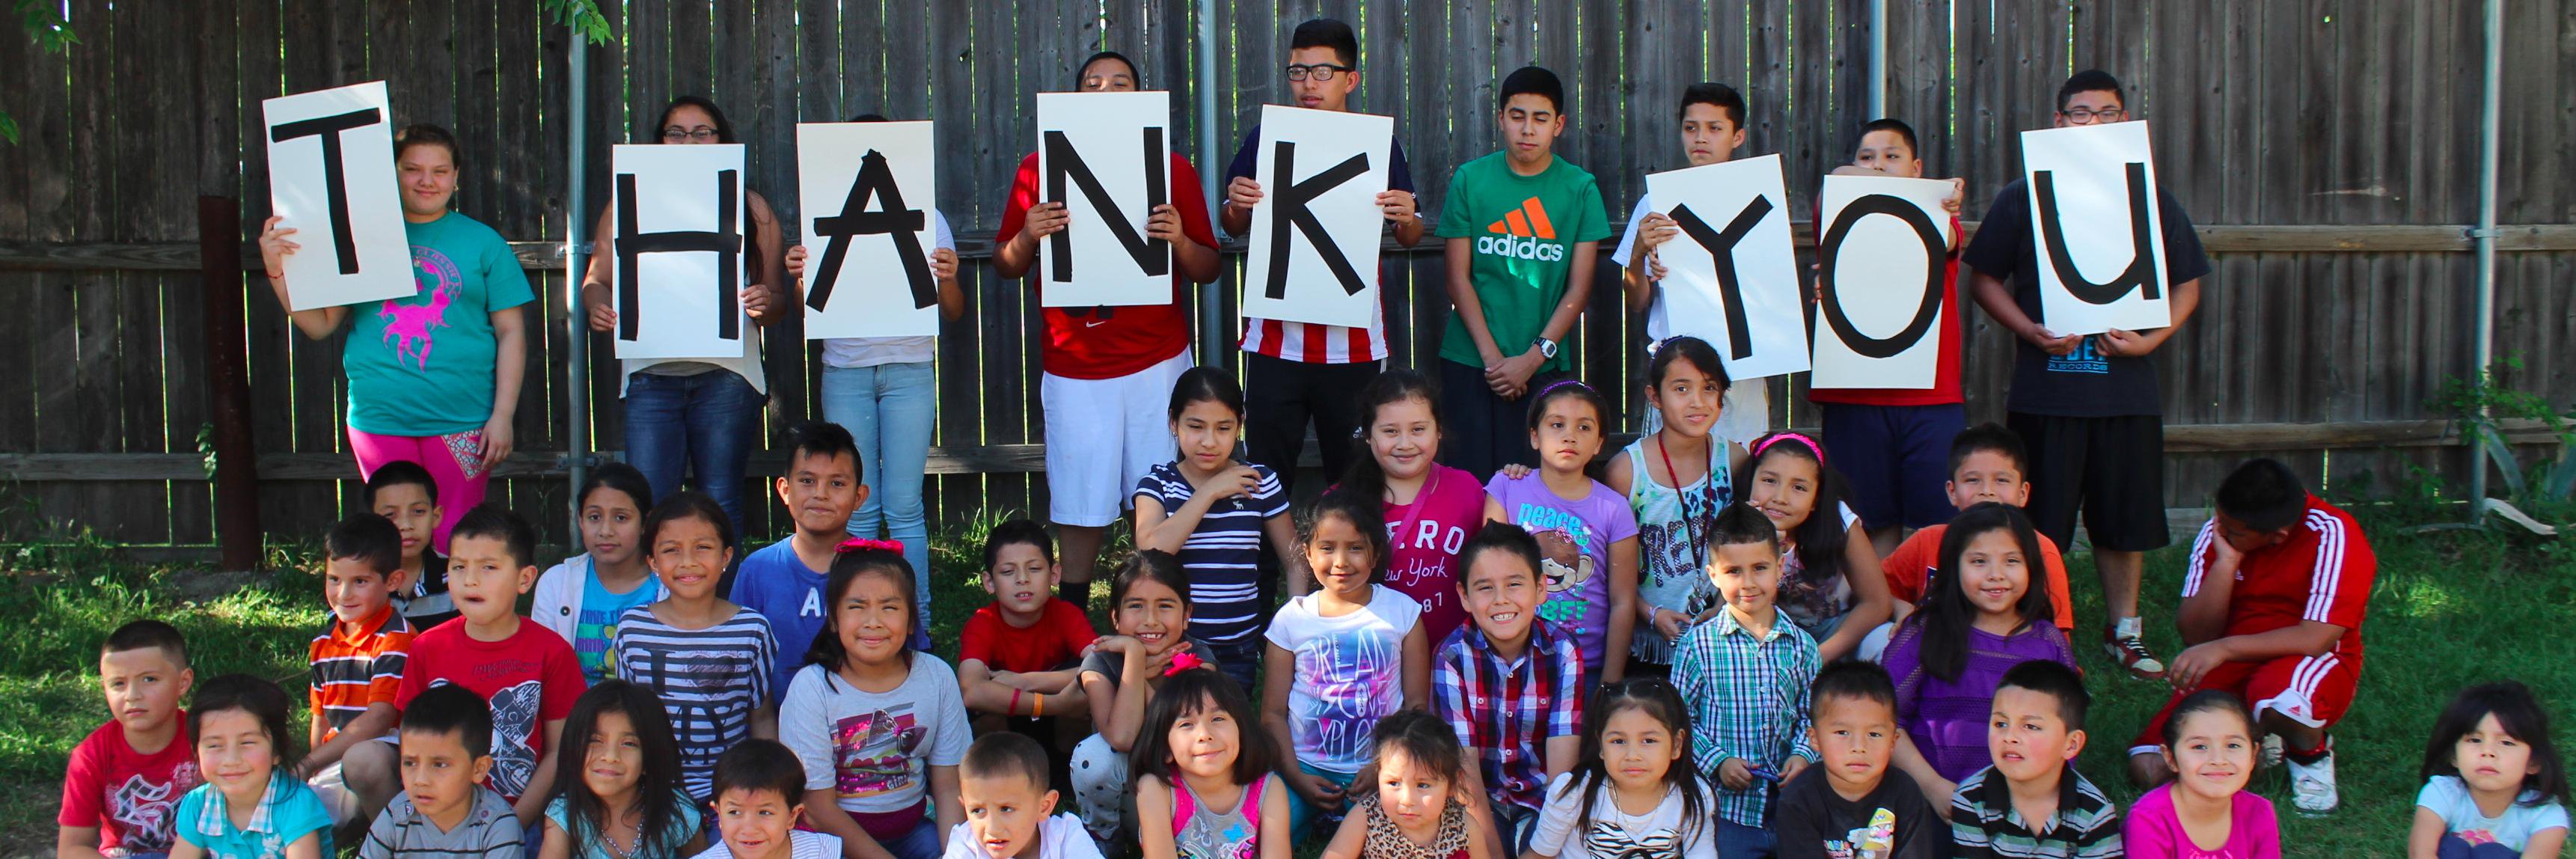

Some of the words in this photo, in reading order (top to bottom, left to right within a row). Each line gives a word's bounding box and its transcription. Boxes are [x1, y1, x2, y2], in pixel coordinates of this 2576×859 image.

[1478, 233, 1564, 262] adidas
[2048, 362, 2108, 371] RECORDS
[1517, 502, 1581, 537] peace
[1407, 556, 1448, 587] York
[1542, 600, 1591, 622] BFF
